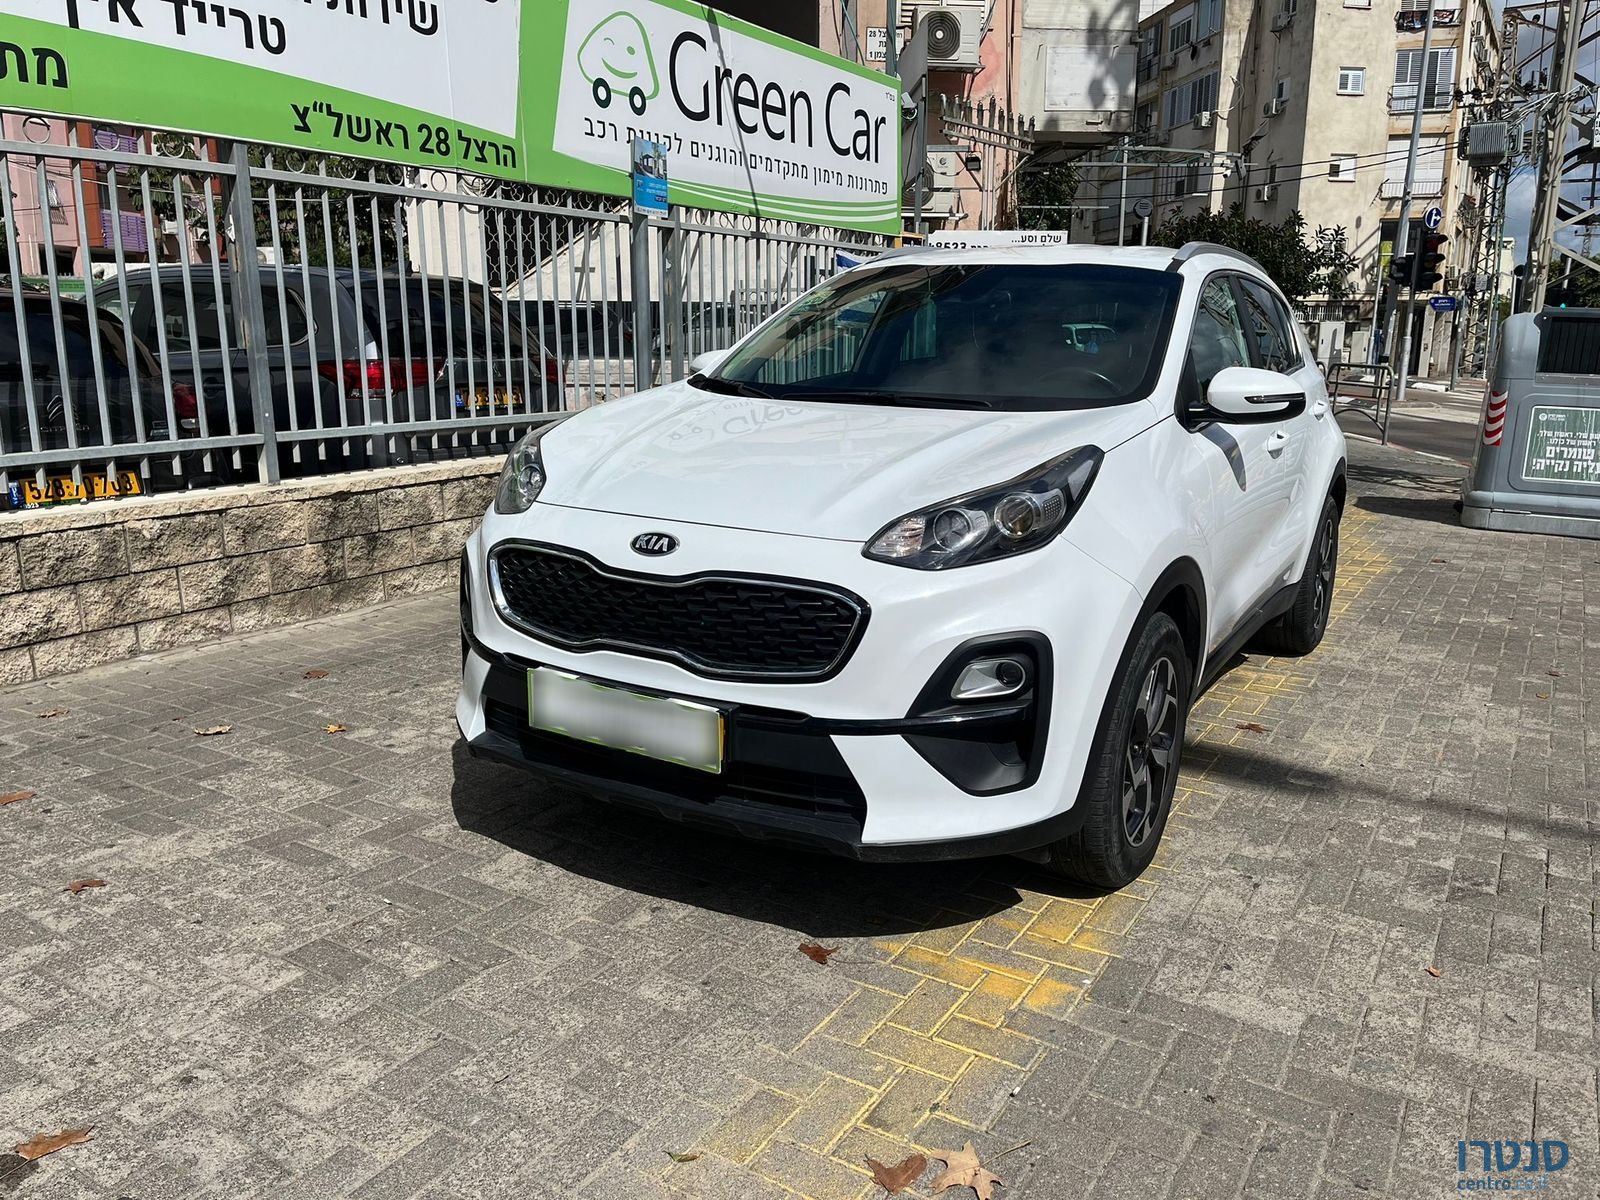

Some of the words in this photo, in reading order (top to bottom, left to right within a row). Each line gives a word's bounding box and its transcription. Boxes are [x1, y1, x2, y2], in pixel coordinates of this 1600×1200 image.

[669, 31, 813, 148] Green
[825, 82, 887, 164] Car
[417, 123, 451, 156] 28
[584, 117, 618, 142] רכב
[457, 129, 517, 168] הרצל
[690, 140, 743, 167] והוגנים
[749, 153, 808, 180] מתקדמים
[813, 167, 843, 186] מימון
[847, 174, 888, 195] פתרונות
[1041, 234, 1062, 244] שלם
[1546, 446, 1596, 460] שומרים
[635, 534, 669, 552] KIA
